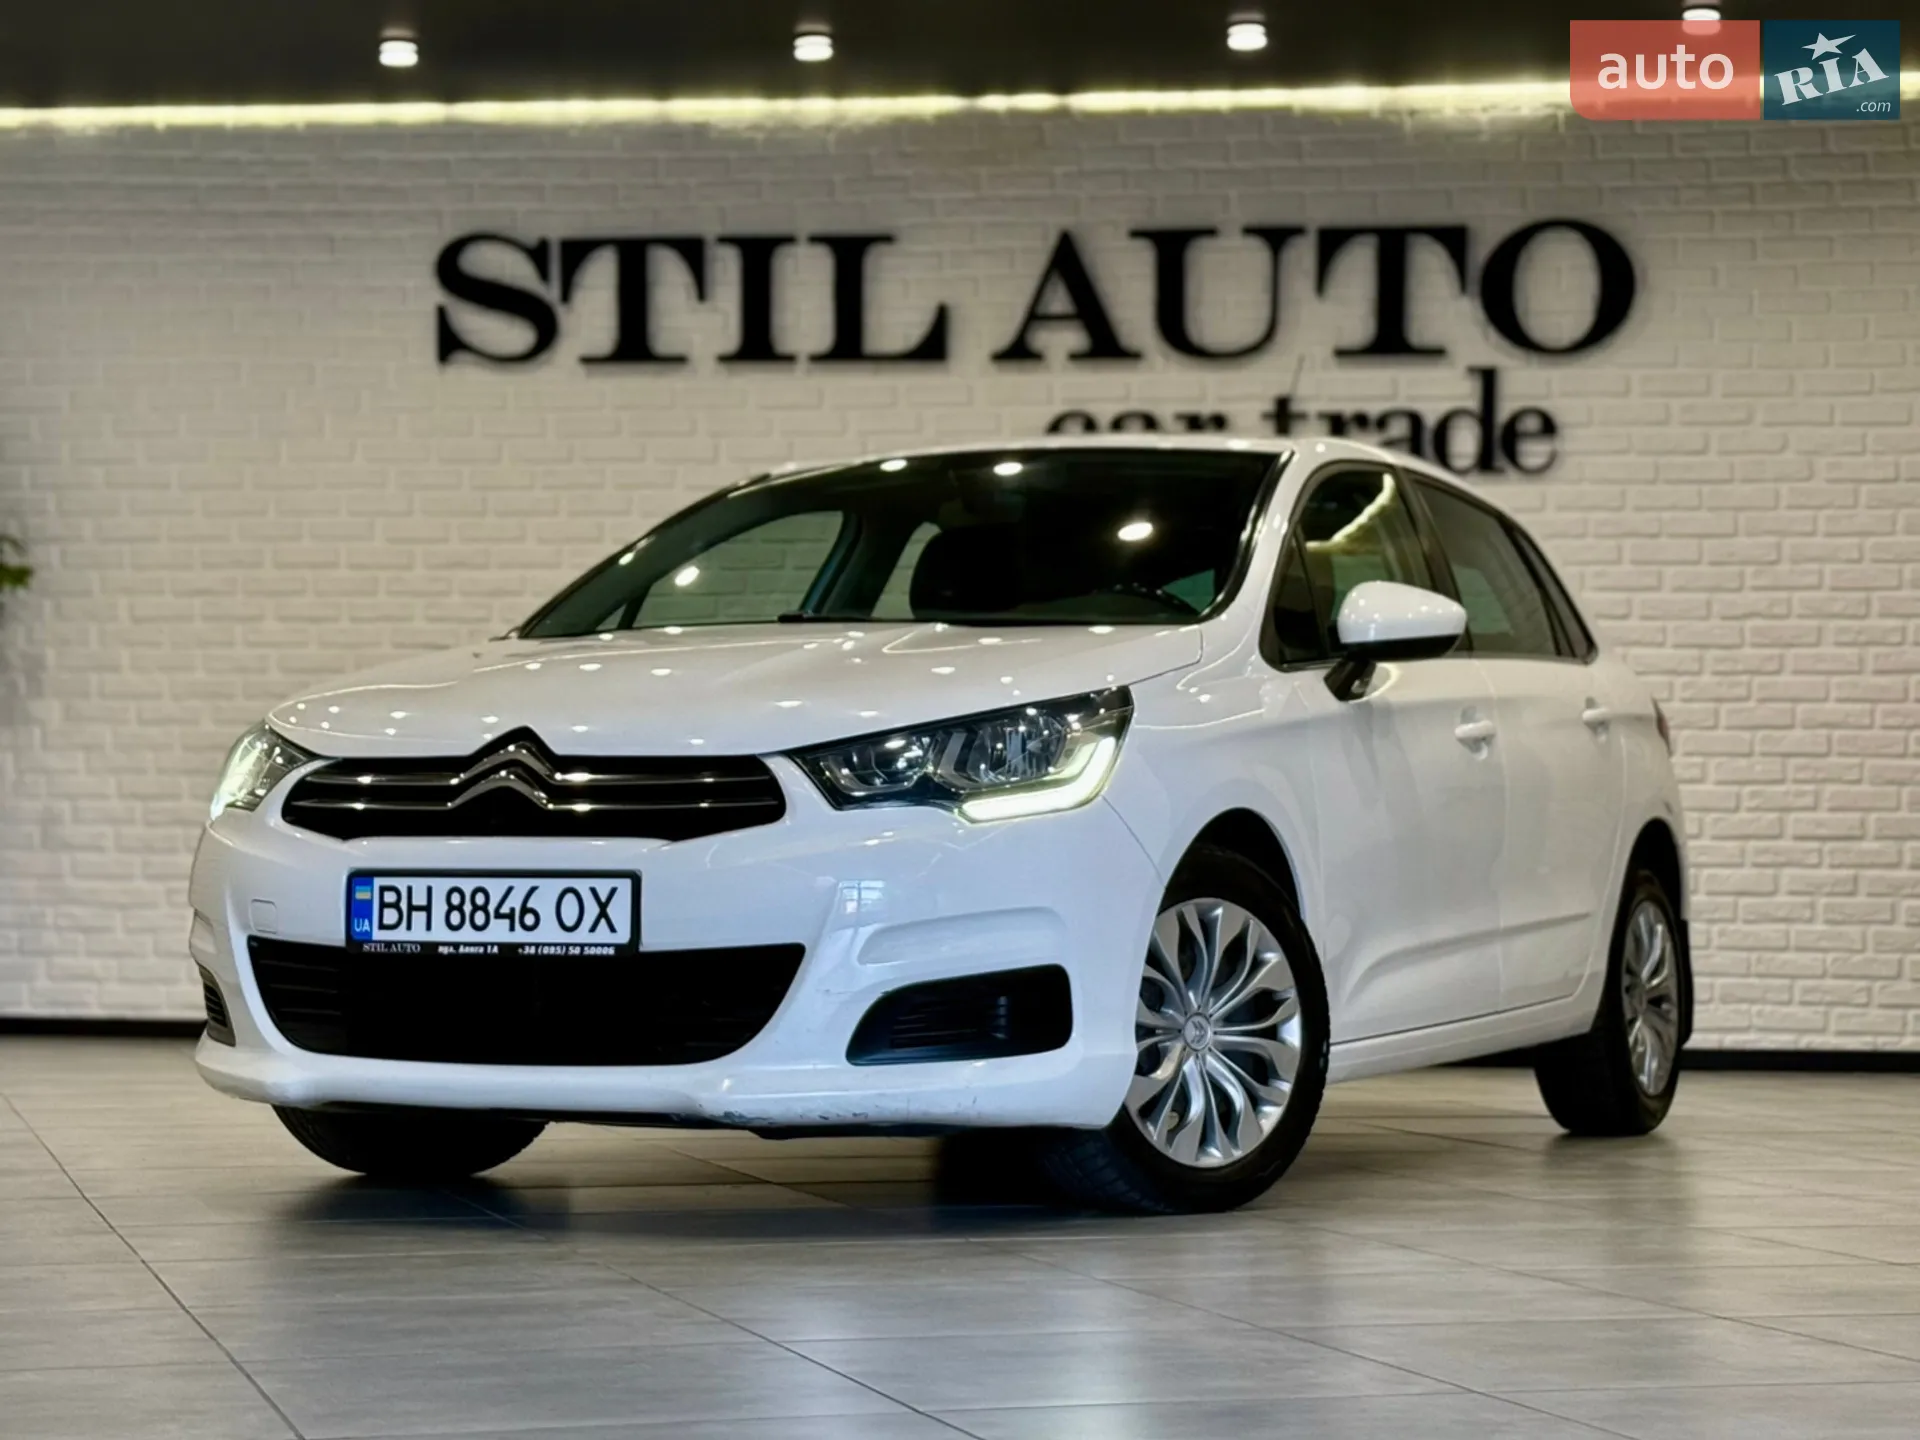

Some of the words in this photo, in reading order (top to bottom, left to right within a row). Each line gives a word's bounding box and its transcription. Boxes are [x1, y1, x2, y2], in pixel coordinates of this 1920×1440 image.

[435, 232, 950, 365] STIL
[990, 218, 1637, 364] AUTO
[354, 917, 371, 933] UA
[377, 884, 434, 932] BH
[444, 885, 541, 933] 8846
[555, 886, 619, 934] OX
[361, 942, 388, 954] STIL
[388, 942, 421, 954] AUTO
